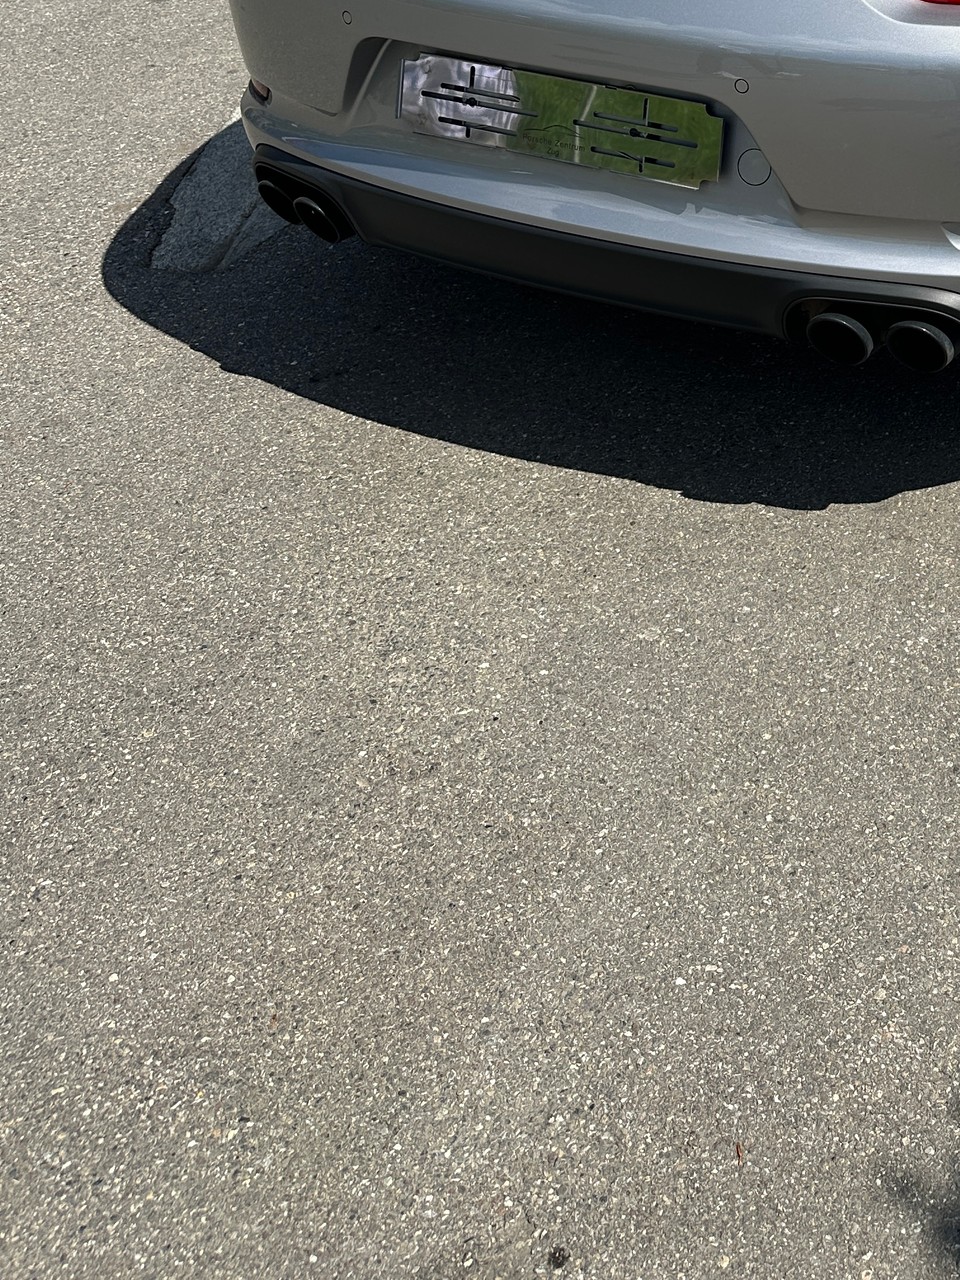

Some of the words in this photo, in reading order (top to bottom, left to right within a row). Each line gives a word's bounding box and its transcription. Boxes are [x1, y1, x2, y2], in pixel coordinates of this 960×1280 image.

[522, 133, 552, 145] Porsche
[554, 139, 586, 152] Zentrum
[546, 147, 560, 157] Zug
